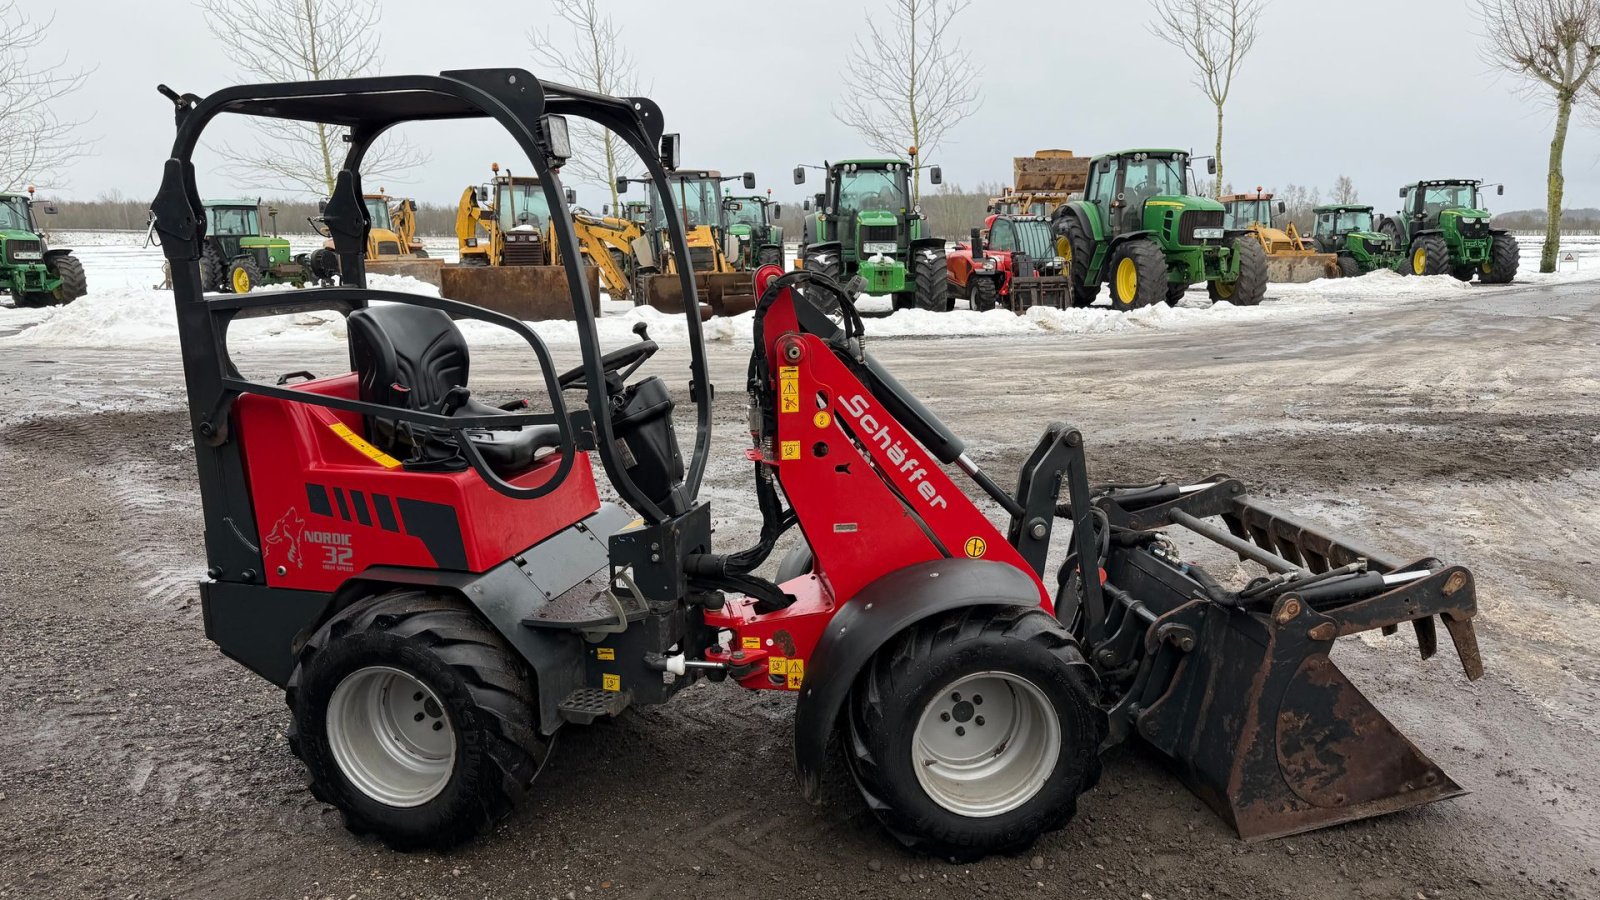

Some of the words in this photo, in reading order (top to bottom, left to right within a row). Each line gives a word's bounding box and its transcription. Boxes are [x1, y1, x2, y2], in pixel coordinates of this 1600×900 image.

[838, 394, 947, 510] Schäffer
[304, 530, 352, 545] NORDIC
[321, 546, 353, 566] 32
